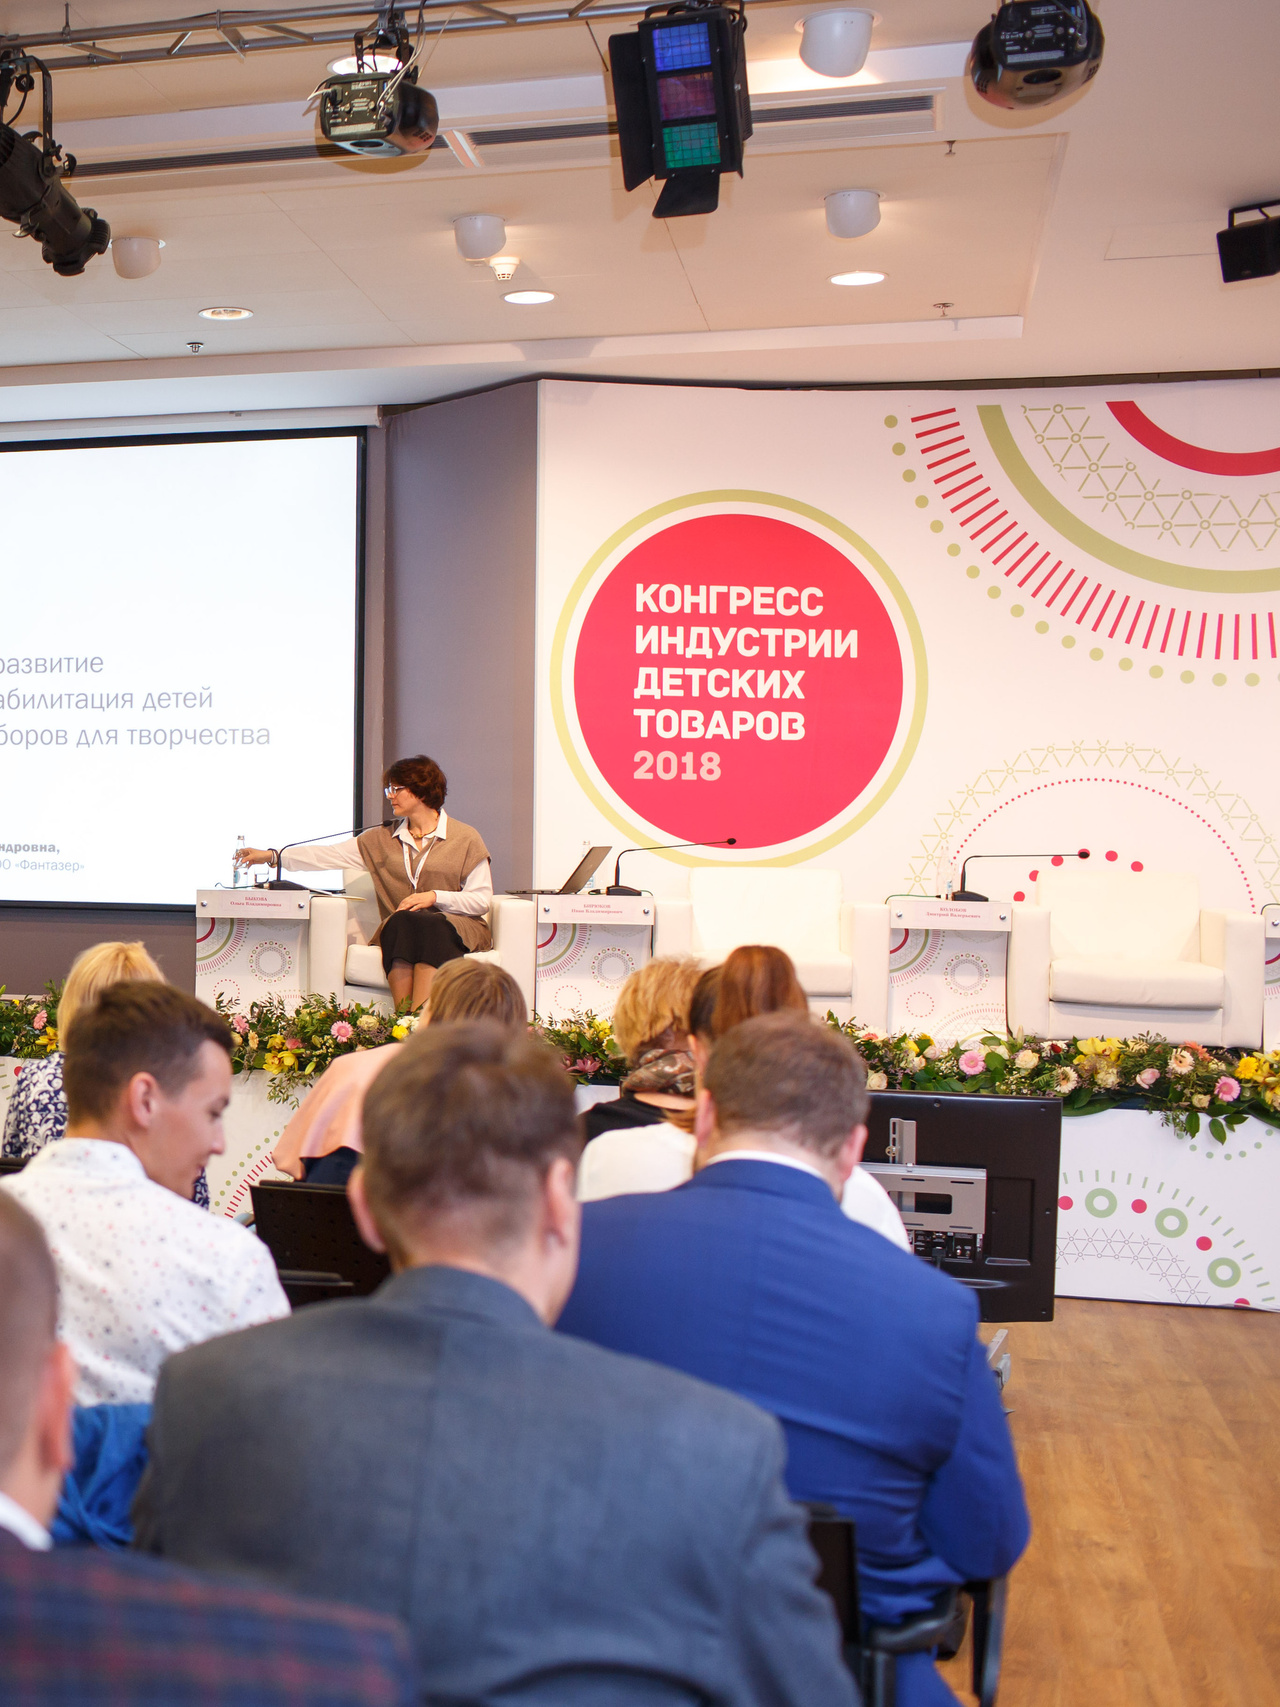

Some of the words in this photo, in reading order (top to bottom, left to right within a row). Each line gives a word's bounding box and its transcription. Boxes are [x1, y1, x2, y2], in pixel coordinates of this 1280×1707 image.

[635, 583, 824, 617] КОНГРЕСС
[635, 625, 858, 659] ИНДУСТРИИ
[142, 686, 213, 712] детей
[633, 666, 806, 700] ДЕТСКИХ
[76, 728, 119, 748] для
[126, 727, 271, 750] творчества
[633, 708, 806, 741] ТОВАРОВ
[633, 750, 722, 781] 2018
